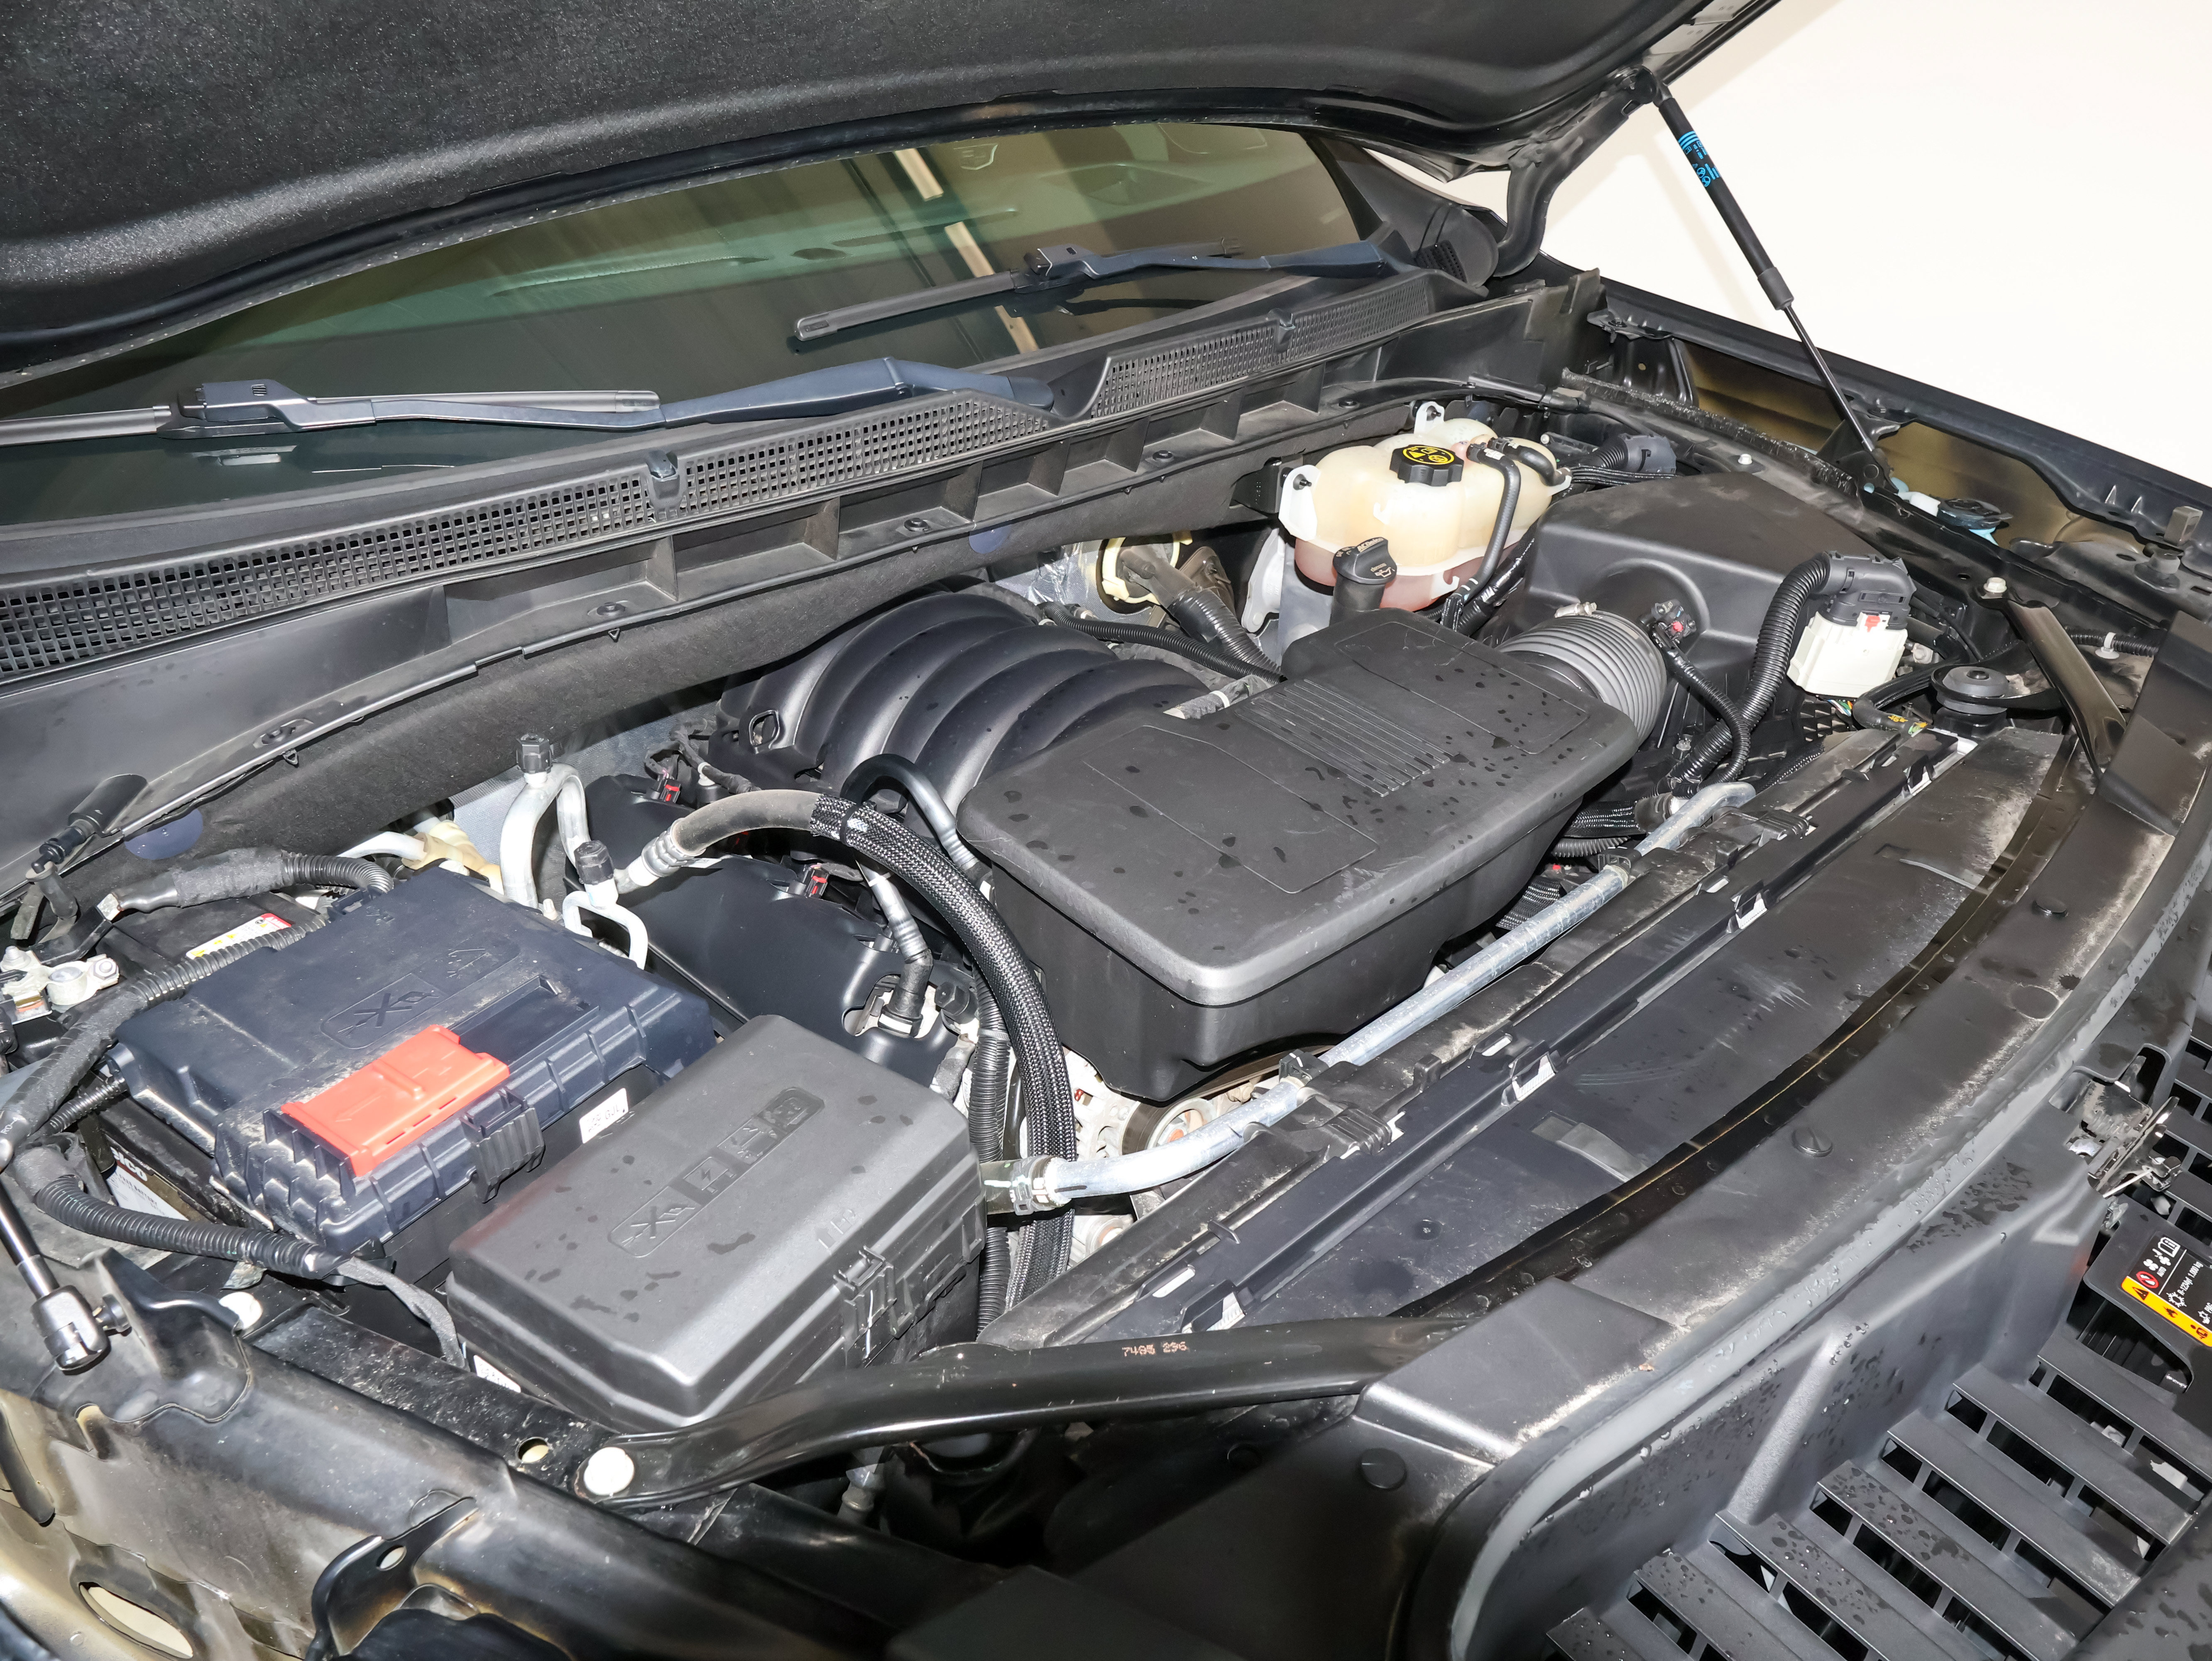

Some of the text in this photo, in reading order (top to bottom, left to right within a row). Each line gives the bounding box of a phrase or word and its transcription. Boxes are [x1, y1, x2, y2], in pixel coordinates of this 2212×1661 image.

[1357, 537, 1384, 553] ACDelco
[2157, 1266, 2167, 1277] AUTO
[2177, 1276, 2193, 1296] R-1234yf
[2188, 1266, 2199, 1278] 1.000
